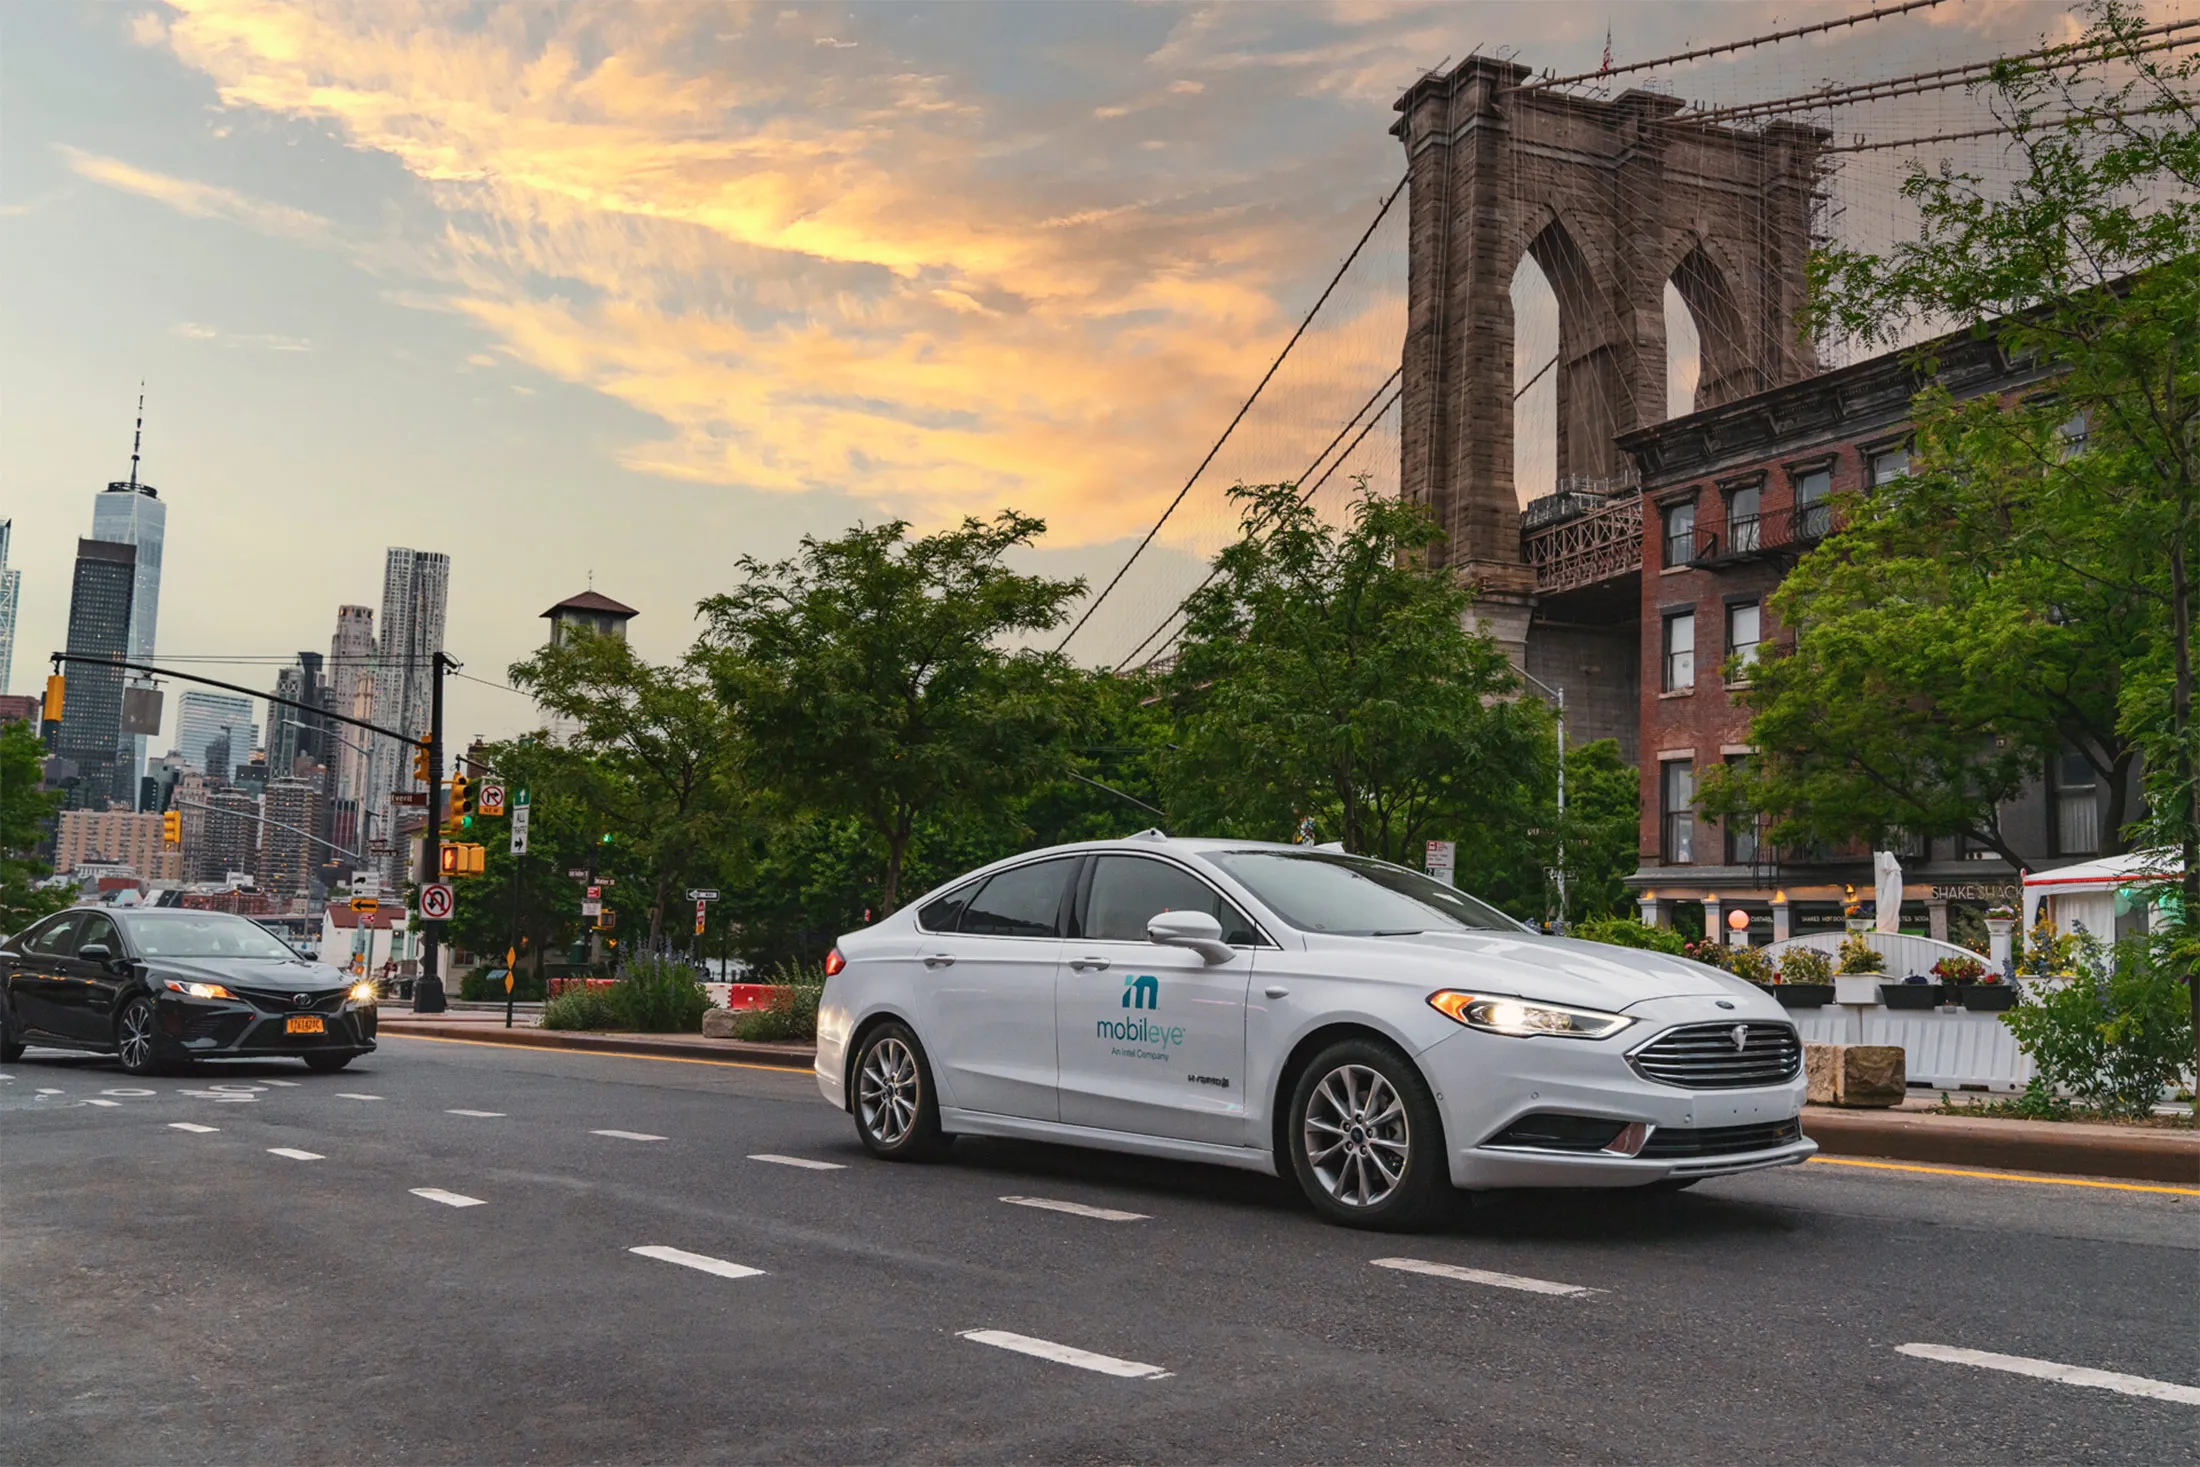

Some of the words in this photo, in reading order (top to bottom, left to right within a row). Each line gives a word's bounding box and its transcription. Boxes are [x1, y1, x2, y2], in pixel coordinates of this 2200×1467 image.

[1931, 885, 1975, 900] SHAKE
[1977, 884, 2024, 900] SHACK
[1097, 1016, 1184, 1050] mobileye
[1111, 1047, 1121, 1056] An
[1121, 1048, 1136, 1058] Intel
[1136, 1049, 1170, 1062] Company
